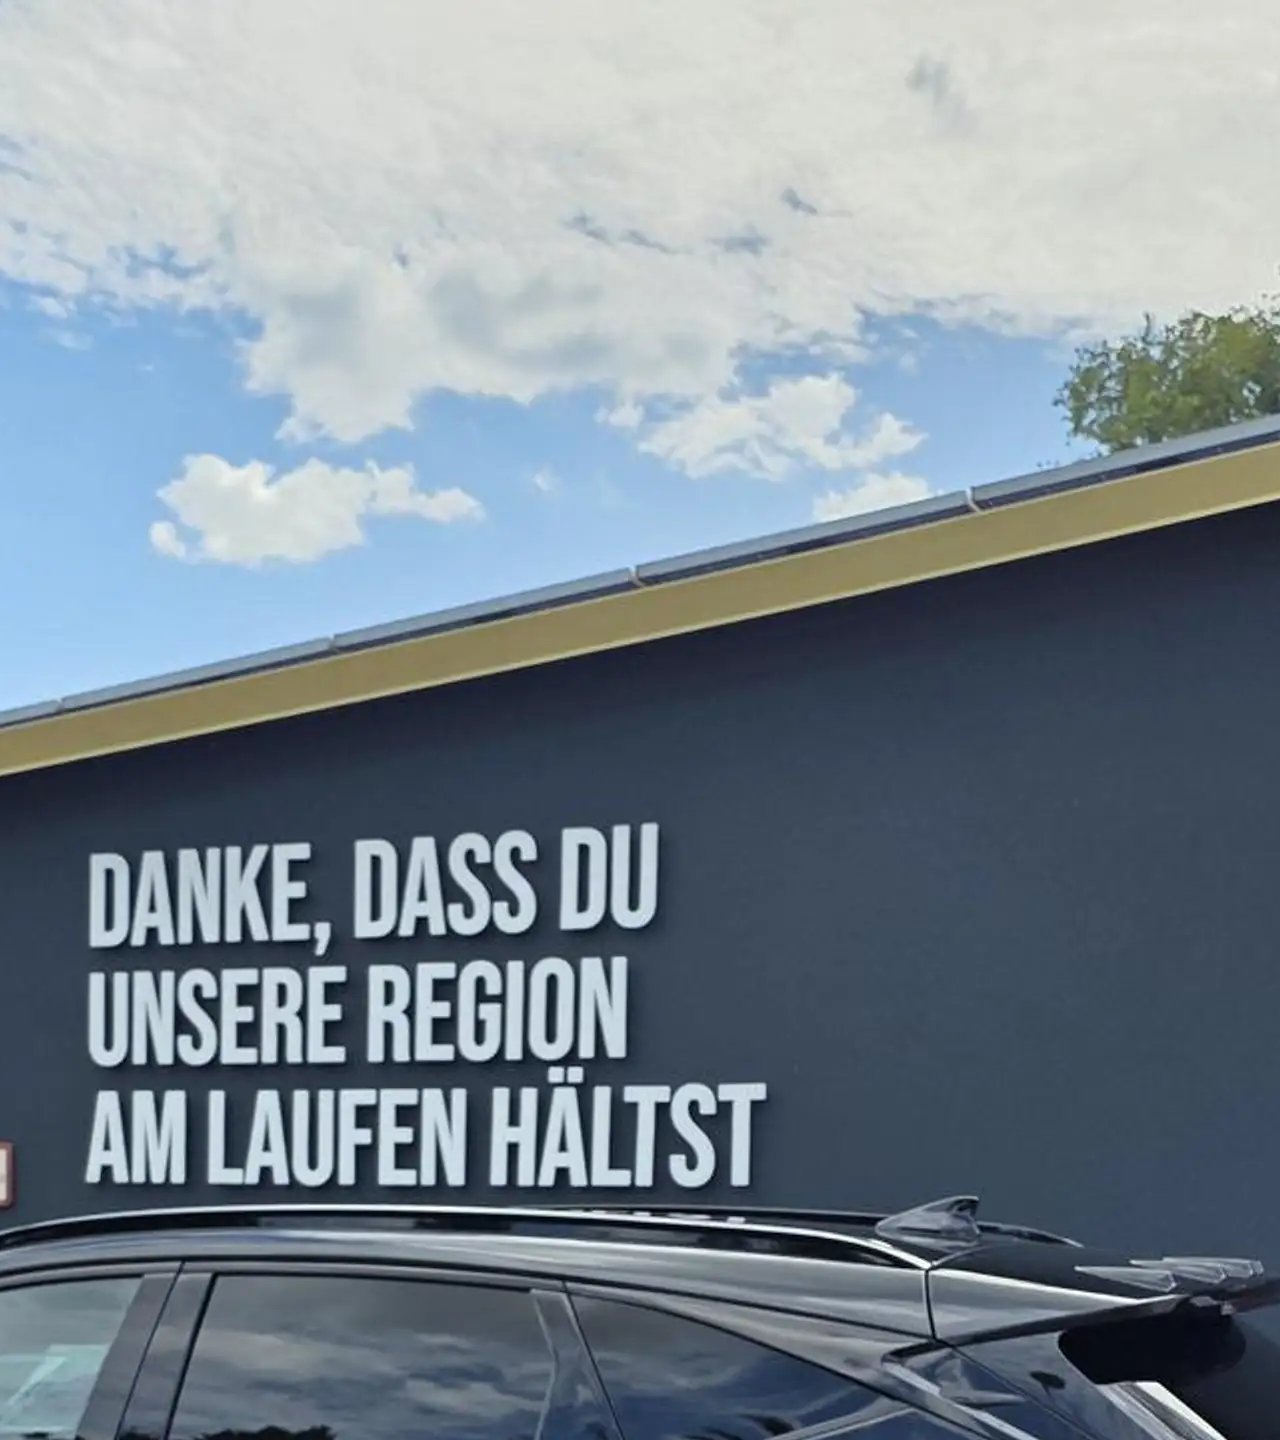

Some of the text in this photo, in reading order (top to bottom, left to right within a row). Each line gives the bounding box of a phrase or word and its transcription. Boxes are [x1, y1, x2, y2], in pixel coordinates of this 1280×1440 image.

[89, 822, 659, 955] DANKE, DASS DU
[88, 955, 628, 1067] UNSERE REGION
[85, 1066, 767, 1188] AM LAUFEN HÄLTST
